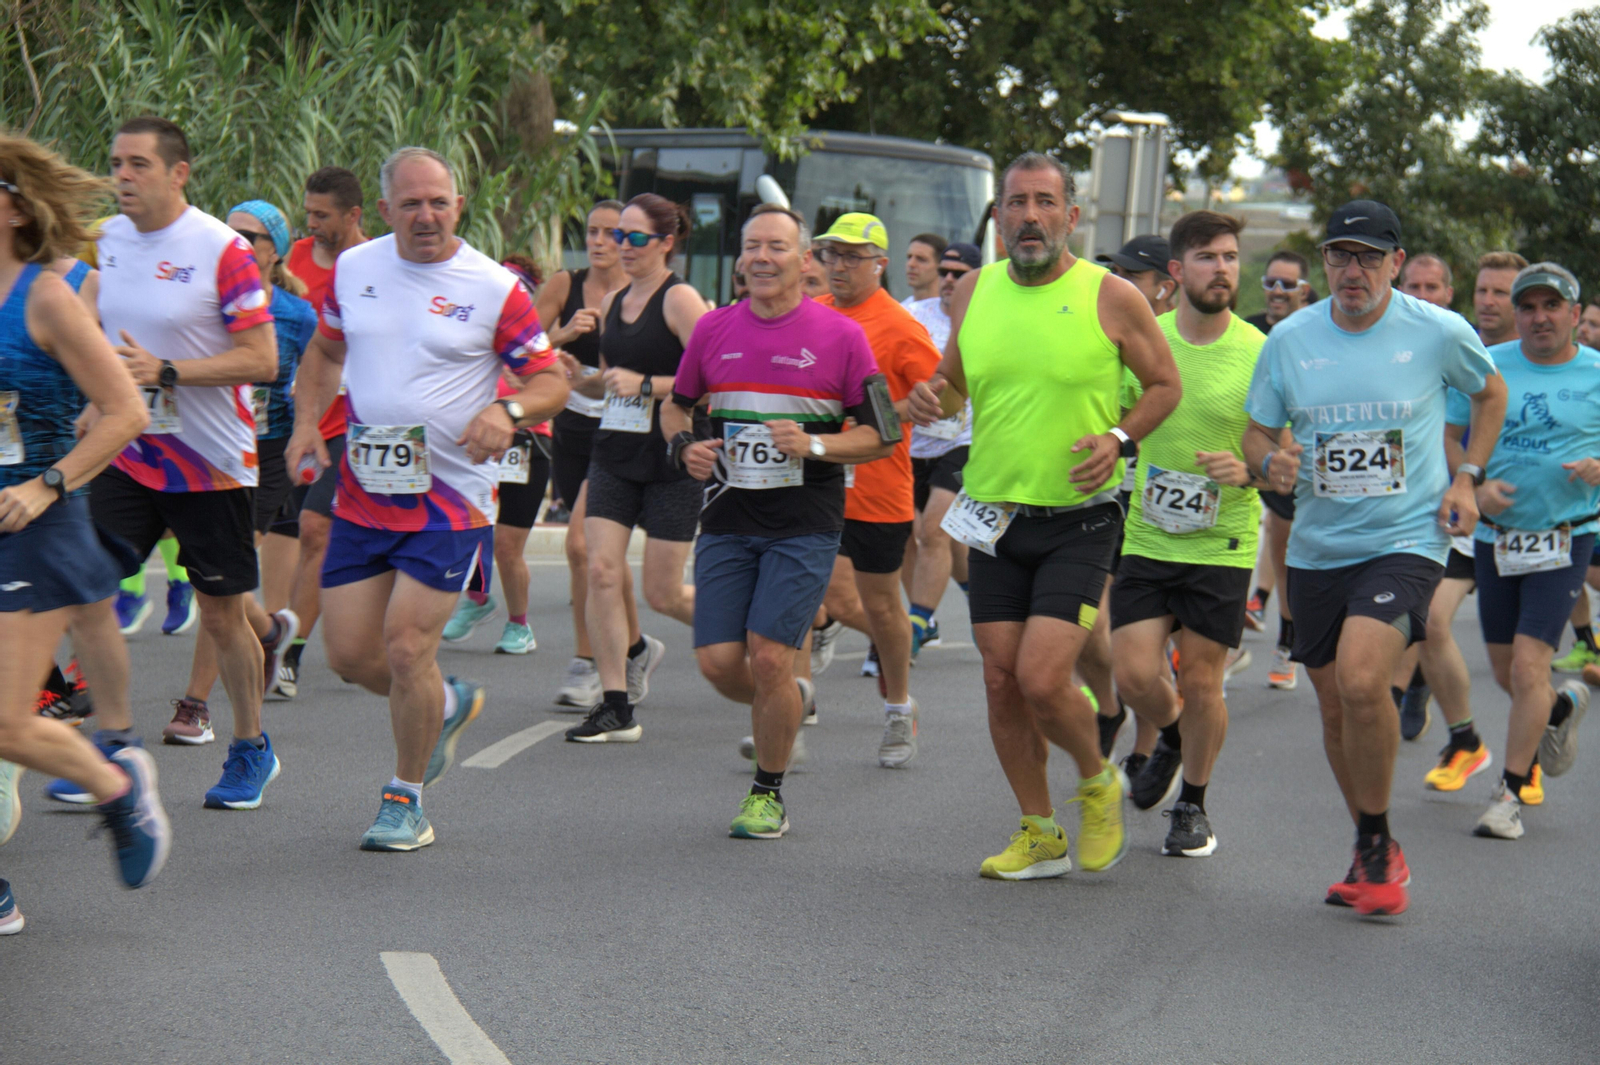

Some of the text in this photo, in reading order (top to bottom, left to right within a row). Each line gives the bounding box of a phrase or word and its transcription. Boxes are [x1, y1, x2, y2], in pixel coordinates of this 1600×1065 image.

[1305, 400, 1413, 424] VALENCIA
[360, 442, 412, 468] 779
[736, 441, 788, 465] 763
[1501, 434, 1552, 454] PADUL
[1327, 445, 1390, 473] 524
[1154, 483, 1204, 514] 724
[963, 496, 994, 529] 1142
[1507, 532, 1555, 554] 421
